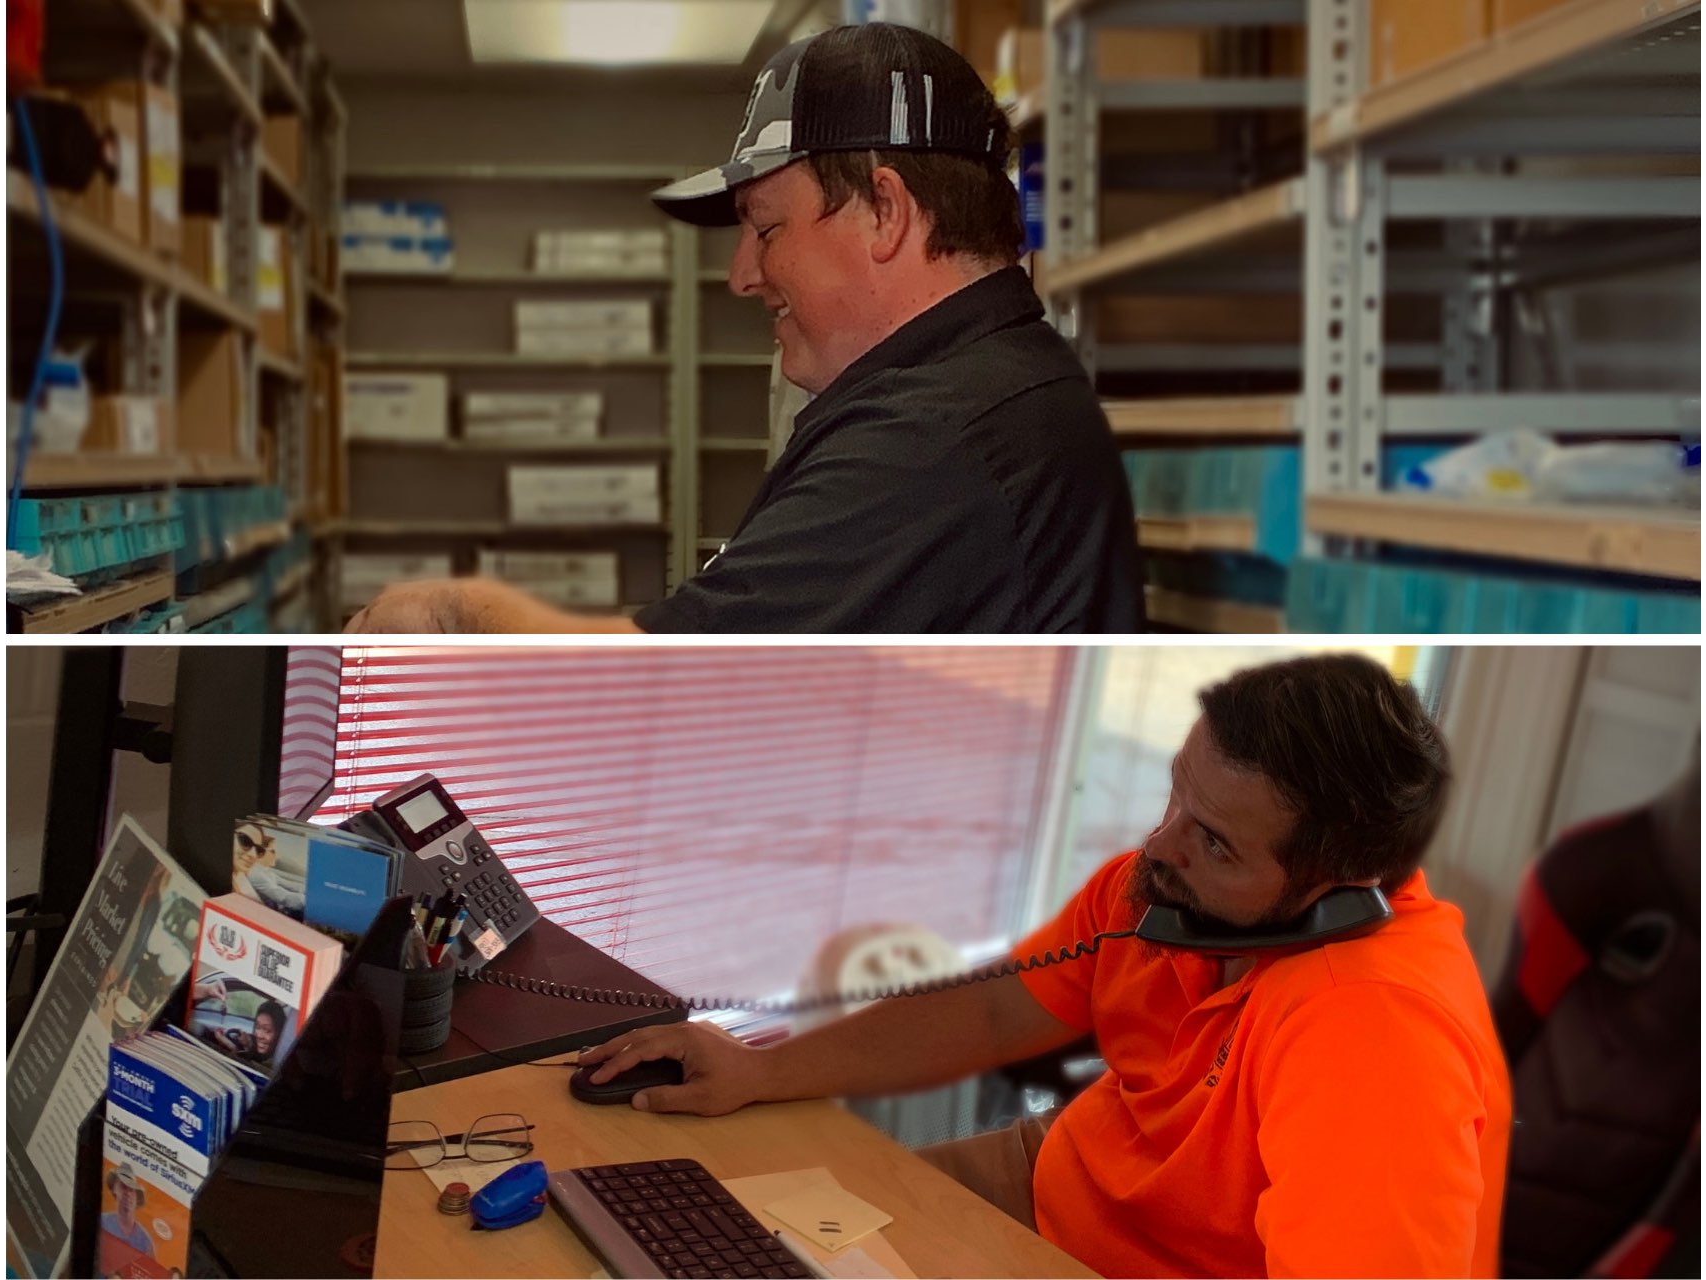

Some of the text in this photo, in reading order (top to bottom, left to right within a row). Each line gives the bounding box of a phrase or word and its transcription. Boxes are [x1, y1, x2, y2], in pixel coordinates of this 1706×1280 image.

[96, 889, 125, 935] Market
[82, 918, 112, 969] Pricing
[113, 1065, 155, 1093] 3-MONTH
[108, 1138, 121, 1154] the
[124, 1148, 149, 1167] world
[150, 1163, 159, 1173] of
[109, 1129, 187, 1179] vehicle comes with
[111, 1115, 178, 1160] Your pre-owned
